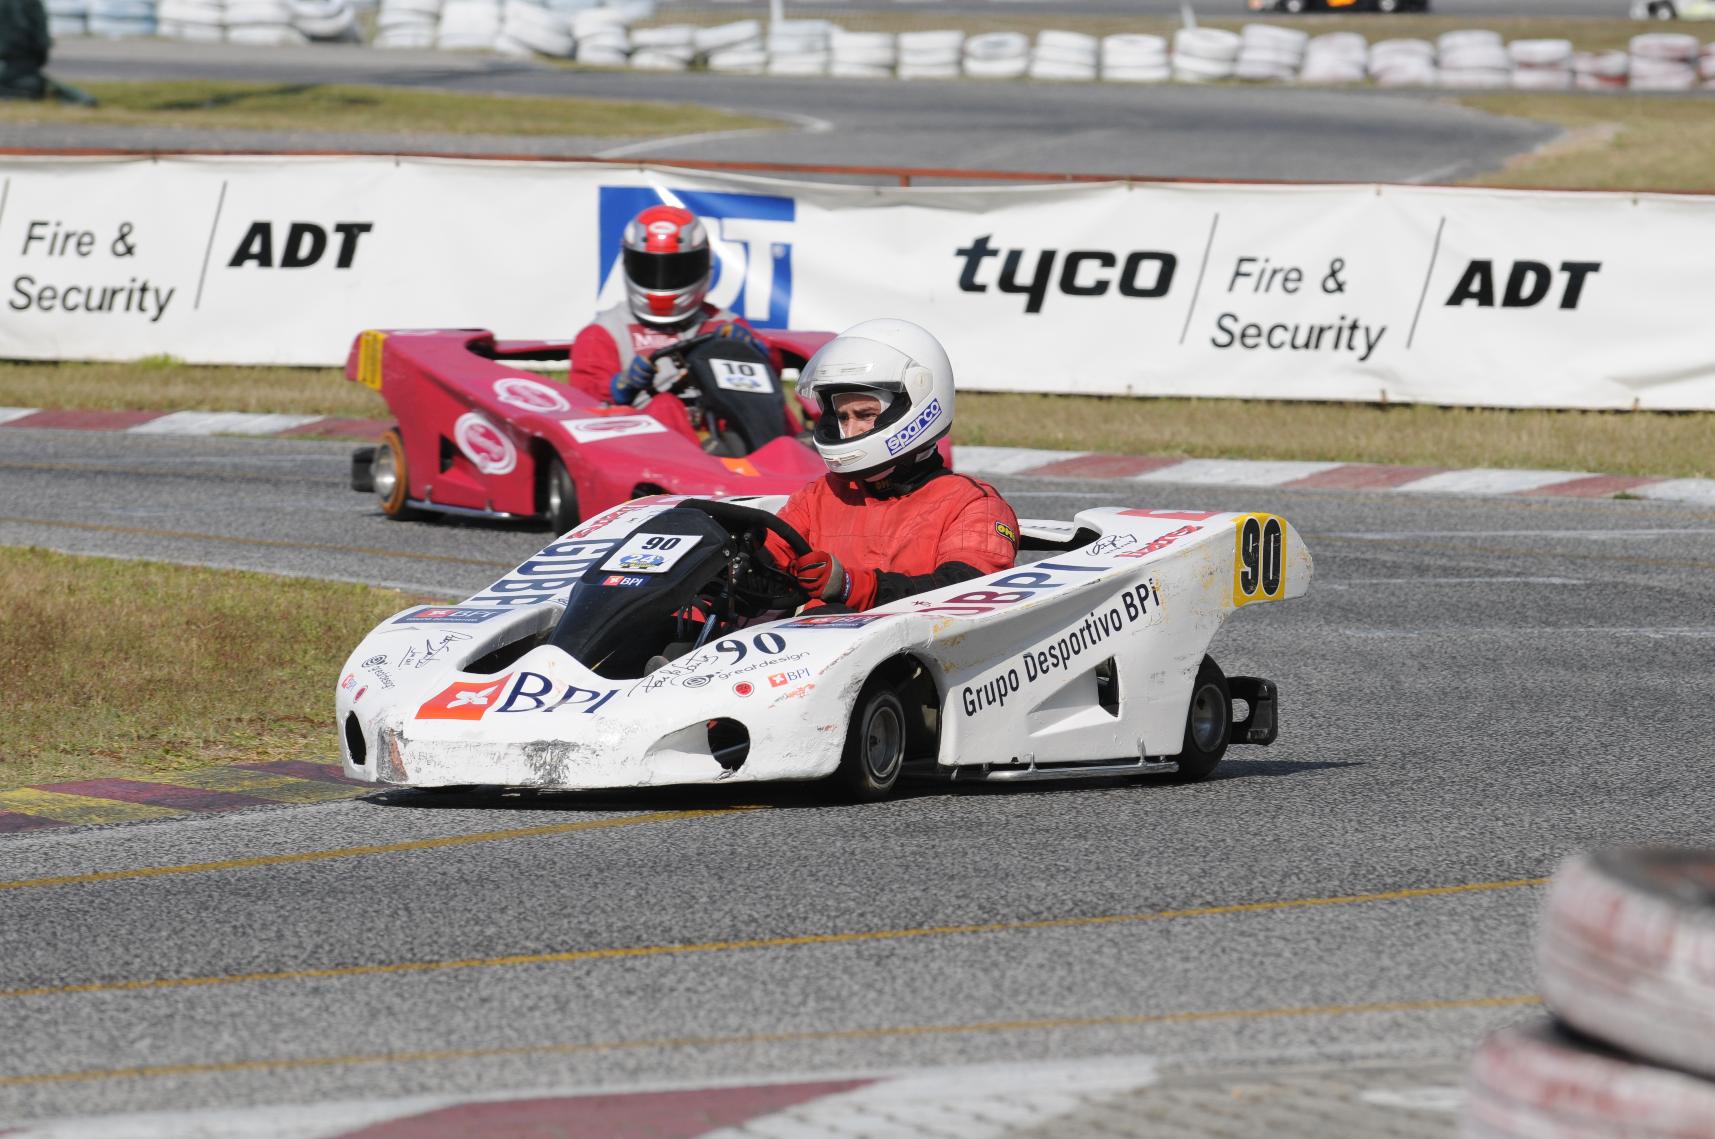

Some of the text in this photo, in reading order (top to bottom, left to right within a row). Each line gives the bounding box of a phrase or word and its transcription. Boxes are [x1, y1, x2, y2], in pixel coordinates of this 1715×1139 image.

[22, 221, 136, 257] Fire &
[228, 222, 373, 268] ADT
[954, 234, 1178, 313] tyco
[1228, 256, 1348, 295] Fire &
[1446, 260, 1602, 310] ADT
[9, 275, 175, 321] Security
[1211, 313, 1386, 361] Security
[721, 363, 756, 377] 10
[886, 399, 940, 452] sparco
[641, 536, 681, 551] 90
[1240, 518, 1282, 597] 90
[619, 577, 643, 586] BPI
[716, 632, 786, 666] 90
[962, 668, 1019, 716] Grupo
[1023, 608, 1123, 682] Desportivo
[495, 671, 622, 715] BPI
[787, 668, 810, 681] BPI
